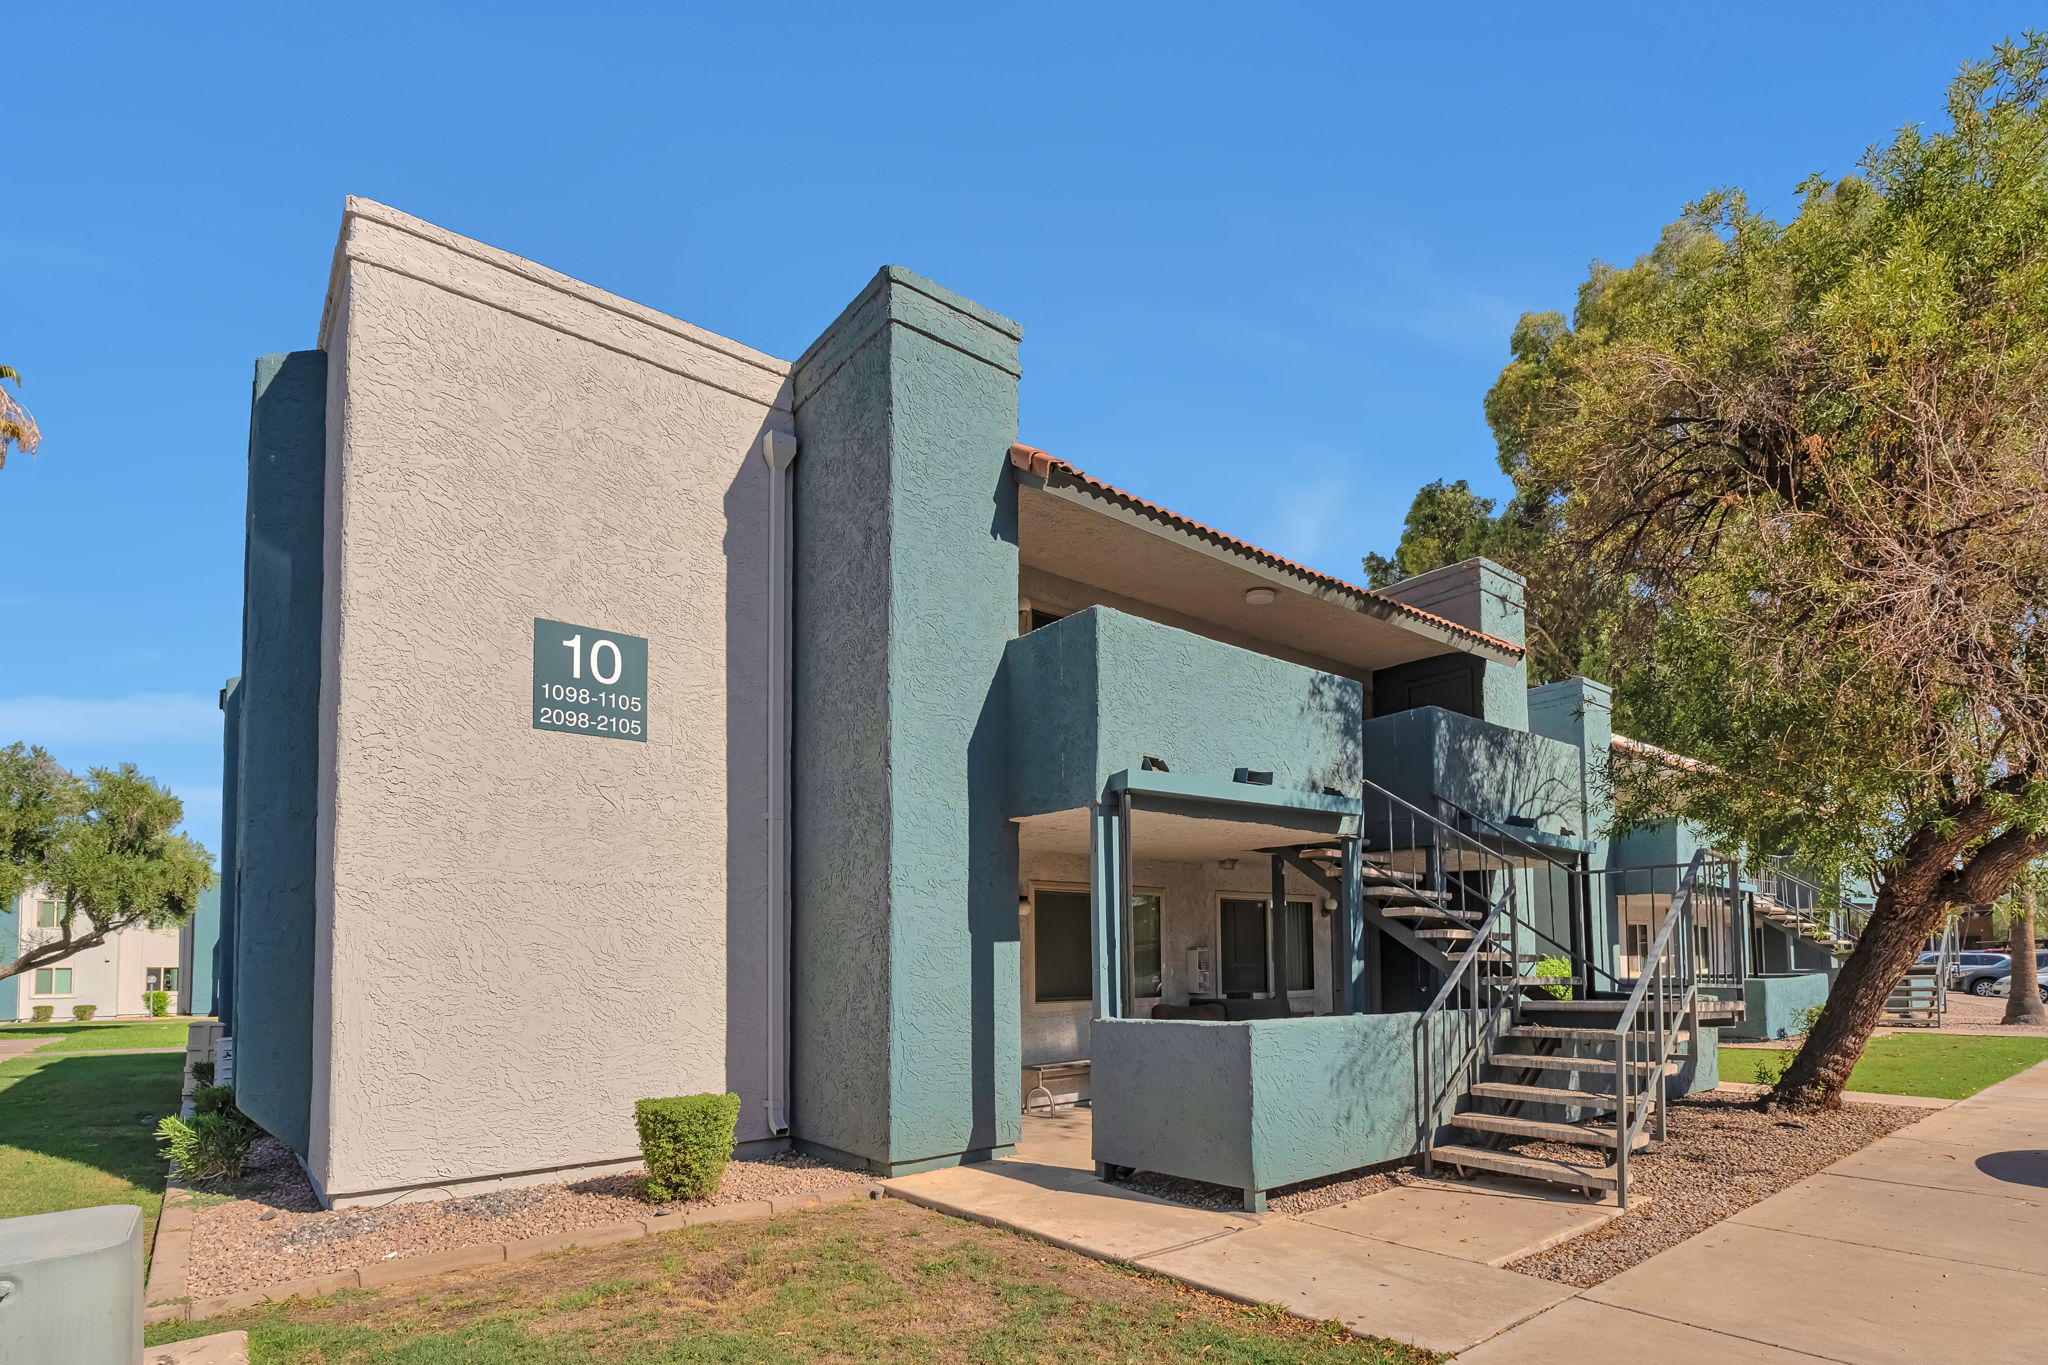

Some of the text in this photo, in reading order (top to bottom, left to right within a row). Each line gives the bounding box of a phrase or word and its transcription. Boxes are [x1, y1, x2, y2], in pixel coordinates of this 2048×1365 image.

[562, 634, 622, 685] 10
[541, 683, 641, 712] 1098-1105
[540, 707, 641, 735] 2098-2105
